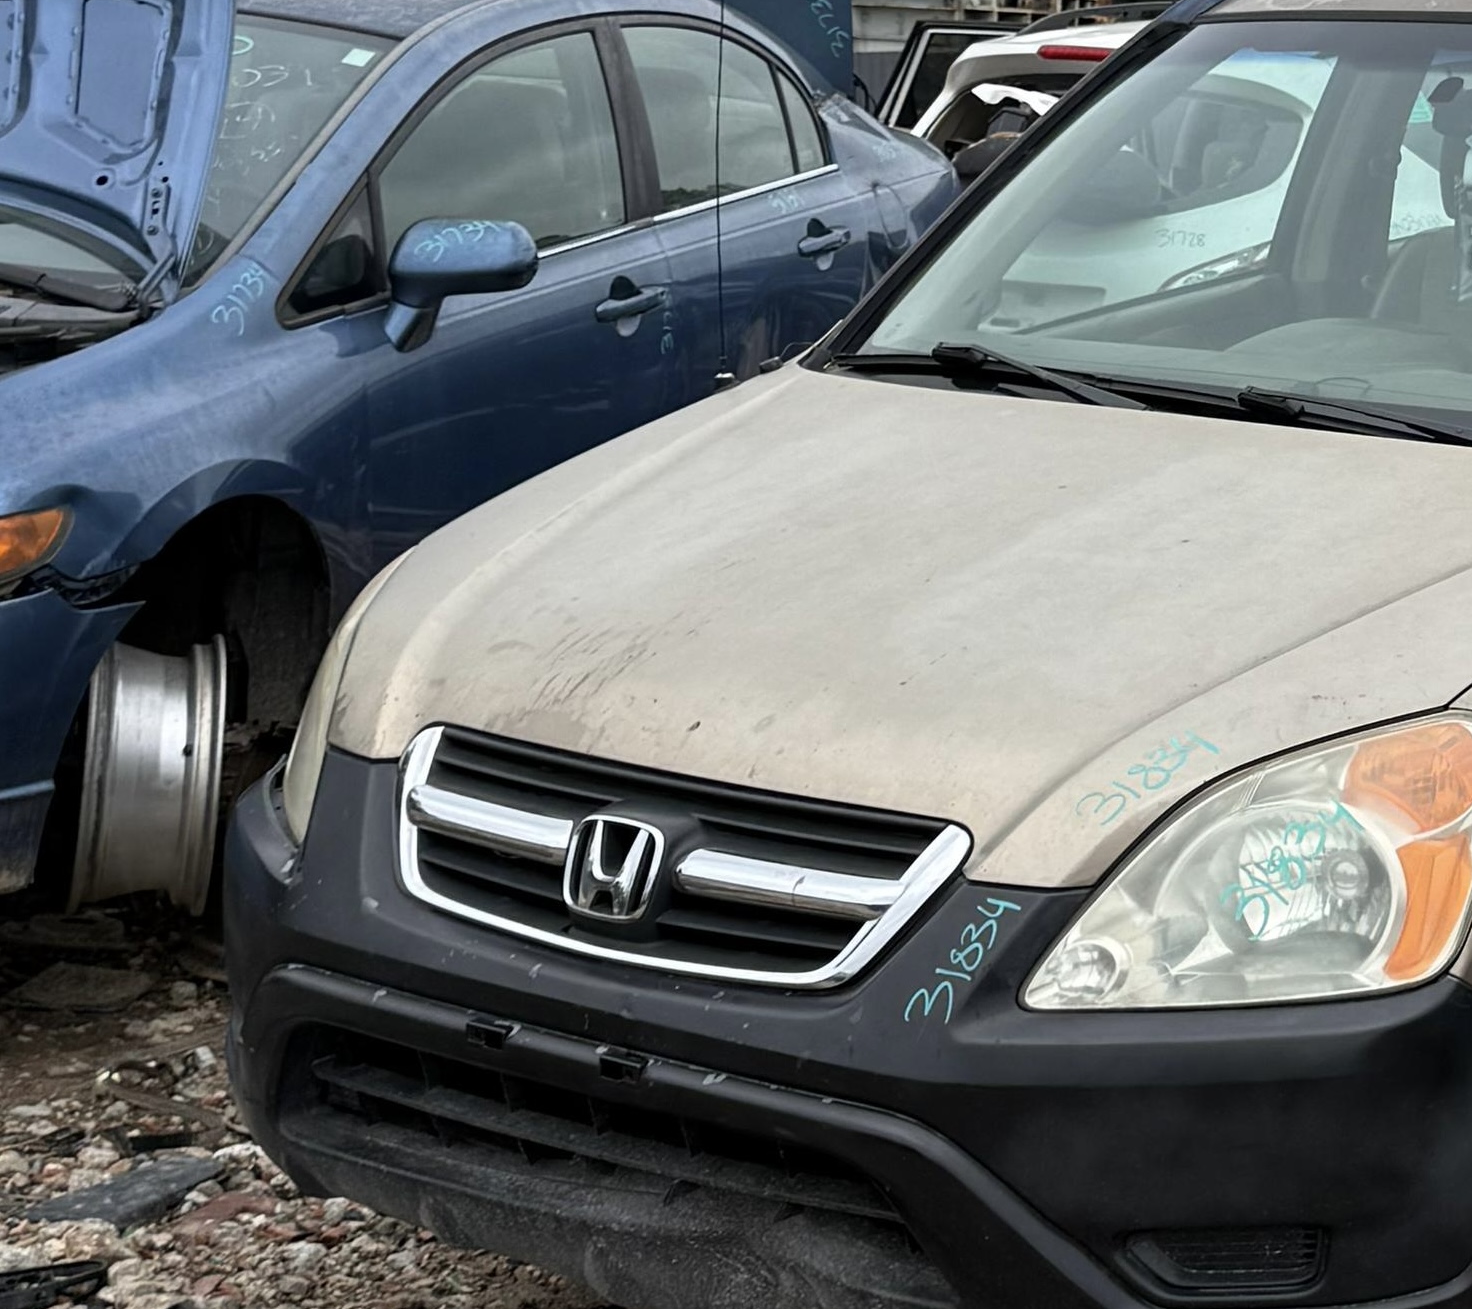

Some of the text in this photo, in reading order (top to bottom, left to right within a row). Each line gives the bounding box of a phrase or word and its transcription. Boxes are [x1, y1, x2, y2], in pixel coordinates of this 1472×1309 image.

[413, 220, 502, 263] 31734
[210, 263, 274, 337] 31734
[1076, 729, 1222, 827] 31834
[1219, 798, 1366, 942] 31834
[904, 897, 1022, 1025] 31834
